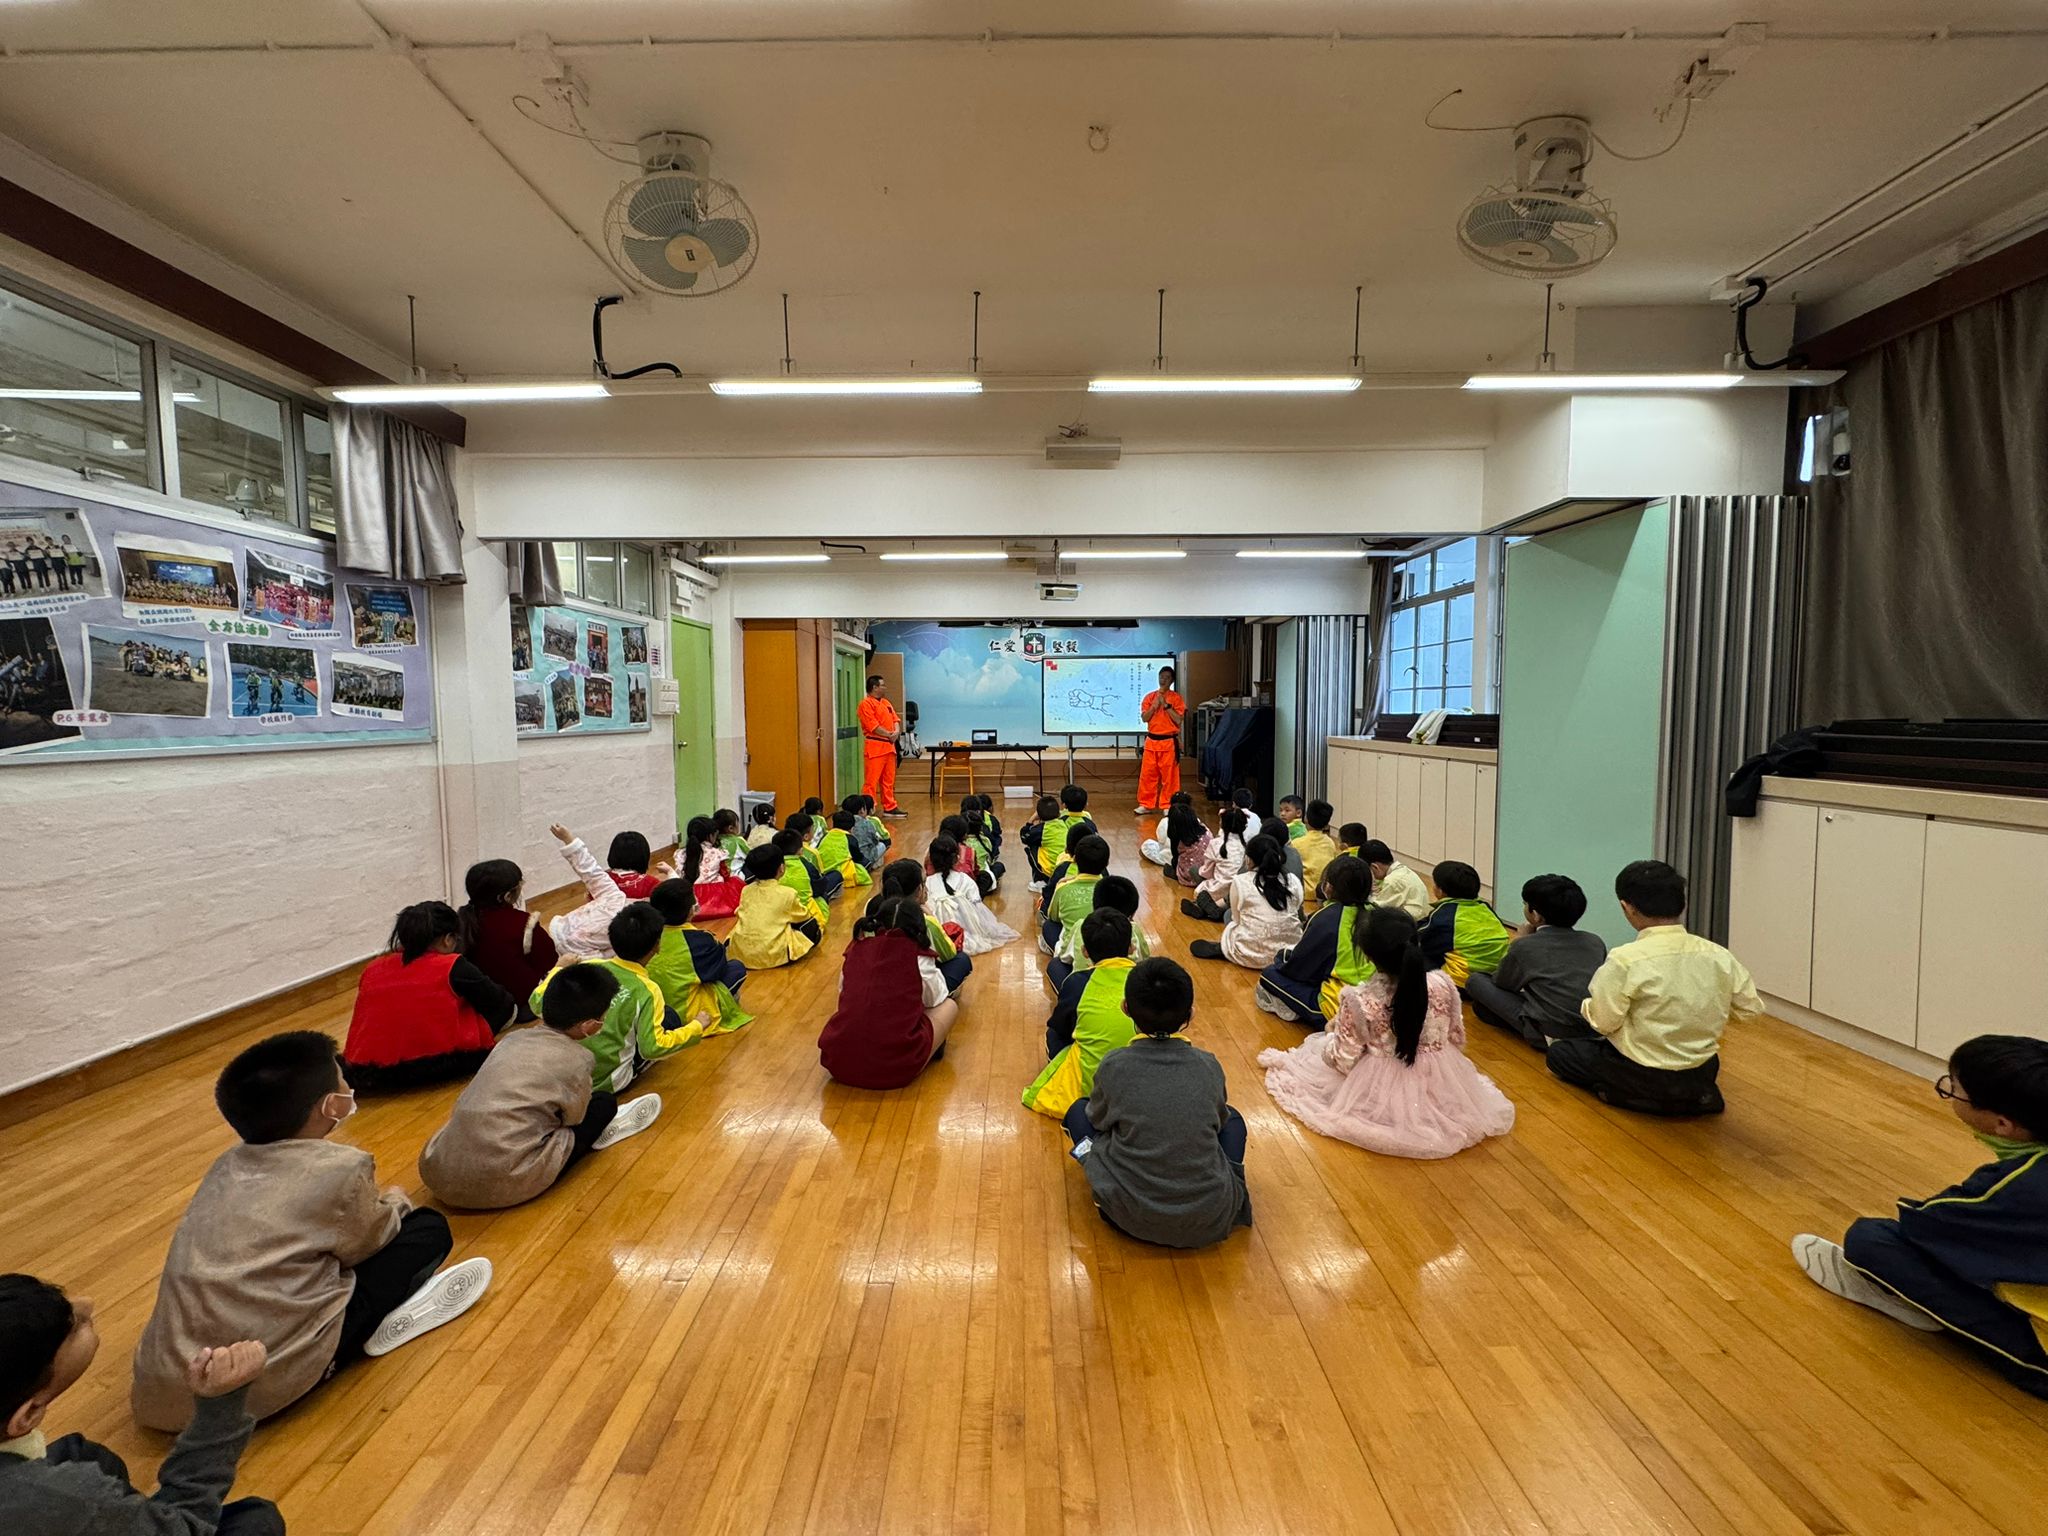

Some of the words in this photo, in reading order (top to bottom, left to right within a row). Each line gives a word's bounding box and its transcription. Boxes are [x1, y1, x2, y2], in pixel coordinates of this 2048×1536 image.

[208, 619, 269, 636] 全方位活動
[989, 639, 1016, 653] 仁愛
[57, 714, 73, 722] P.6
